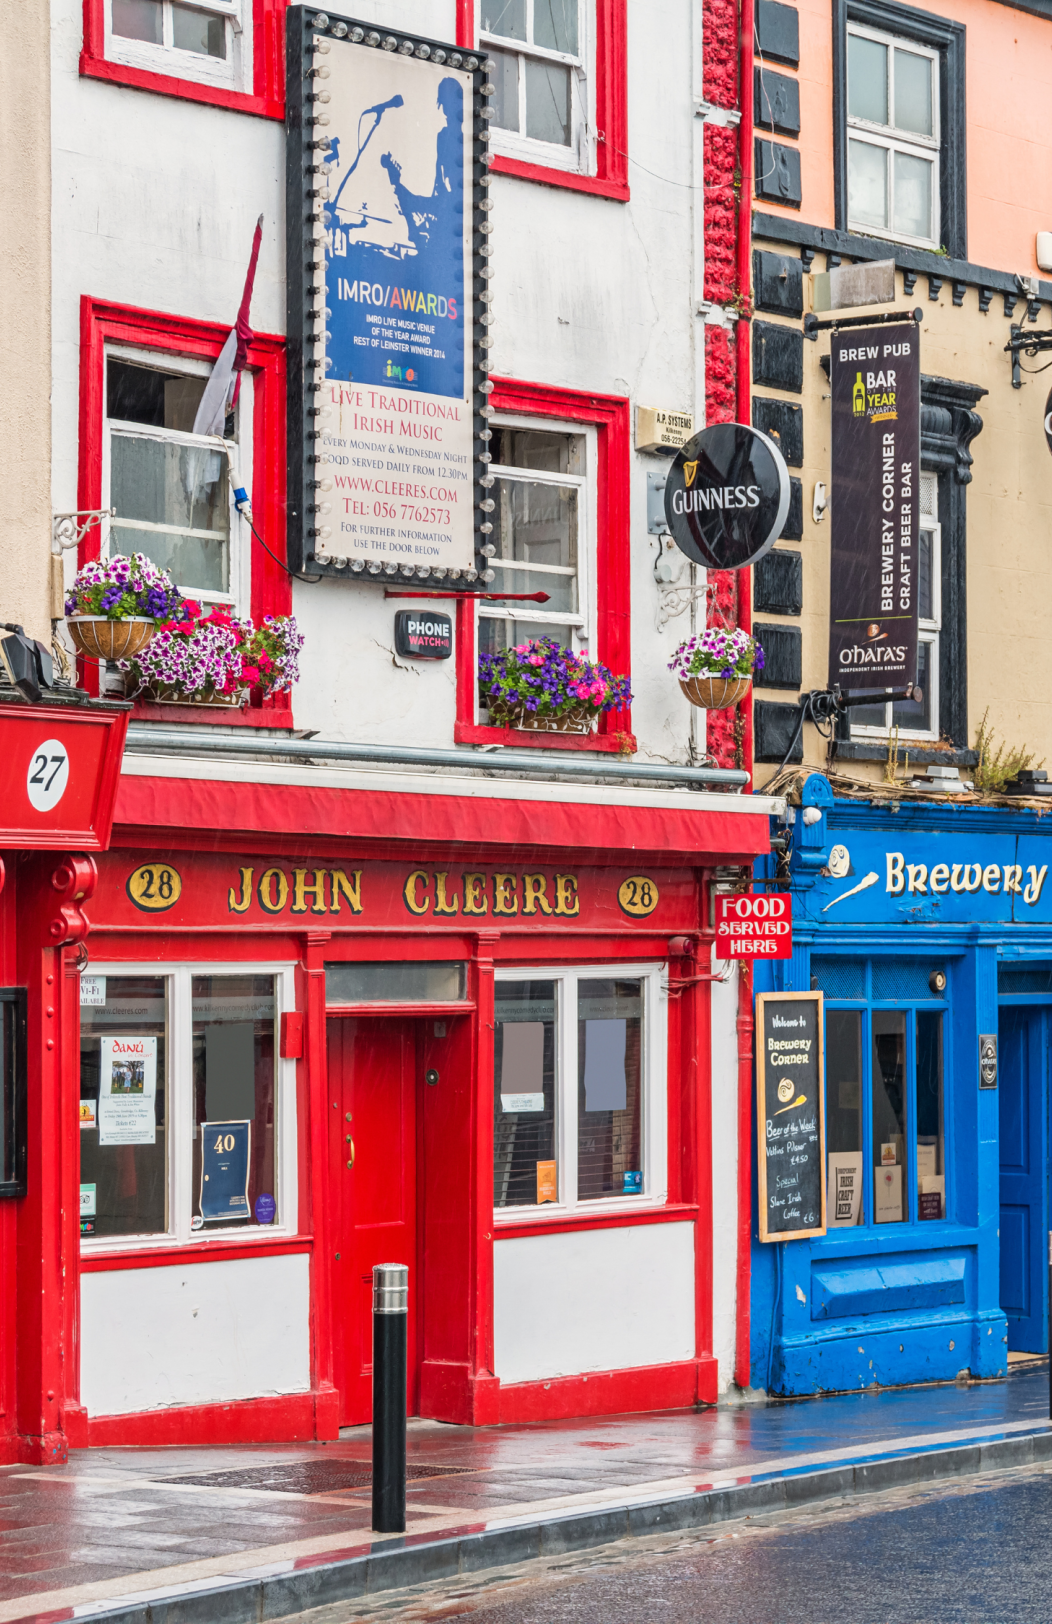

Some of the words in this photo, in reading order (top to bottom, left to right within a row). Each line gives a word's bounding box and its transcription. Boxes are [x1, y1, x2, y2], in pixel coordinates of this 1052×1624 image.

[338, 277, 457, 320] IMRO/AWARDS
[366, 314, 382, 325] IMRO
[383, 317, 397, 327] LIVE
[397, 319, 416, 331] MUSIC
[416, 322, 436, 334] VENUE
[371, 327, 380, 336] OF
[381, 328, 393, 338] THE
[394, 331, 410, 341] YEAR
[410, 333, 431, 345] AWARD
[353, 335, 370, 346] REST
[371, 339, 380, 348] OF
[380, 340, 410, 353] LEINSTER
[410, 345, 433, 357] WINNER
[433, 349, 446, 360] 2014
[839, 346, 879, 362] BREW
[883, 343, 911, 358] PUB
[866, 370, 897, 389] BAR
[331, 386, 363, 407] LIVE
[367, 391, 461, 422] TRADITIONAL
[867, 392, 896, 407] YEAR
[866, 405, 897, 416] AWARDS
[353, 413, 394, 435] IRISH
[399, 419, 443, 442] MUSIC
[668, 414, 692, 430] SYSTEMS
[323, 436, 348, 448] EVERY
[350, 439, 387, 454] MONDAY
[388, 443, 395, 454] &
[396, 444, 442, 461] WEDNESDAY
[443, 451, 468, 464] NIGHT
[352, 457, 384, 470] SERVED
[386, 460, 410, 473] DAILY
[412, 464, 435, 477] FROM
[882, 432, 895, 512] CORNER
[334, 474, 458, 503] WWW.CLEERES.COM
[901, 461, 912, 498] BAR
[672, 485, 760, 515] GUINNESS
[342, 497, 370, 515] TEL:
[373, 501, 397, 519] 056
[400, 504, 451, 525] 7762573
[340, 522, 358, 533] FOR
[359, 525, 396, 537] FURTHER
[397, 529, 452, 543] INFORMATION
[900, 503, 912, 547] BEER
[353, 539, 369, 549] USE
[371, 540, 387, 551] THE
[389, 542, 413, 554] DOOR
[414, 545, 440, 556] BELOW
[881, 519, 895, 611] BREWERY
[900, 553, 912, 610] CRAFT
[408, 620, 450, 637] PHONE
[408, 635, 441, 647] WATCH
[30, 754, 65, 792] 27
[139, 869, 174, 900] 28
[885, 852, 1048, 904] Brewery
[228, 866, 364, 915] JOHN
[403, 870, 580, 918] CLEERE
[626, 880, 653, 908] 28
[722, 897, 785, 918] FOOD
[718, 921, 790, 936] SERVED
[730, 939, 777, 955] HERE
[95, 1007, 148, 1015] www.cleeres.com
[799, 1015, 807, 1027] to
[766, 1120, 783, 1138] Beer
[784, 1123, 791, 1134] of
[790, 1122, 798, 1132] the
[799, 1118, 816, 1131] Week
[213, 1134, 236, 1154] 40
[783, 1208, 800, 1220] Coffee
